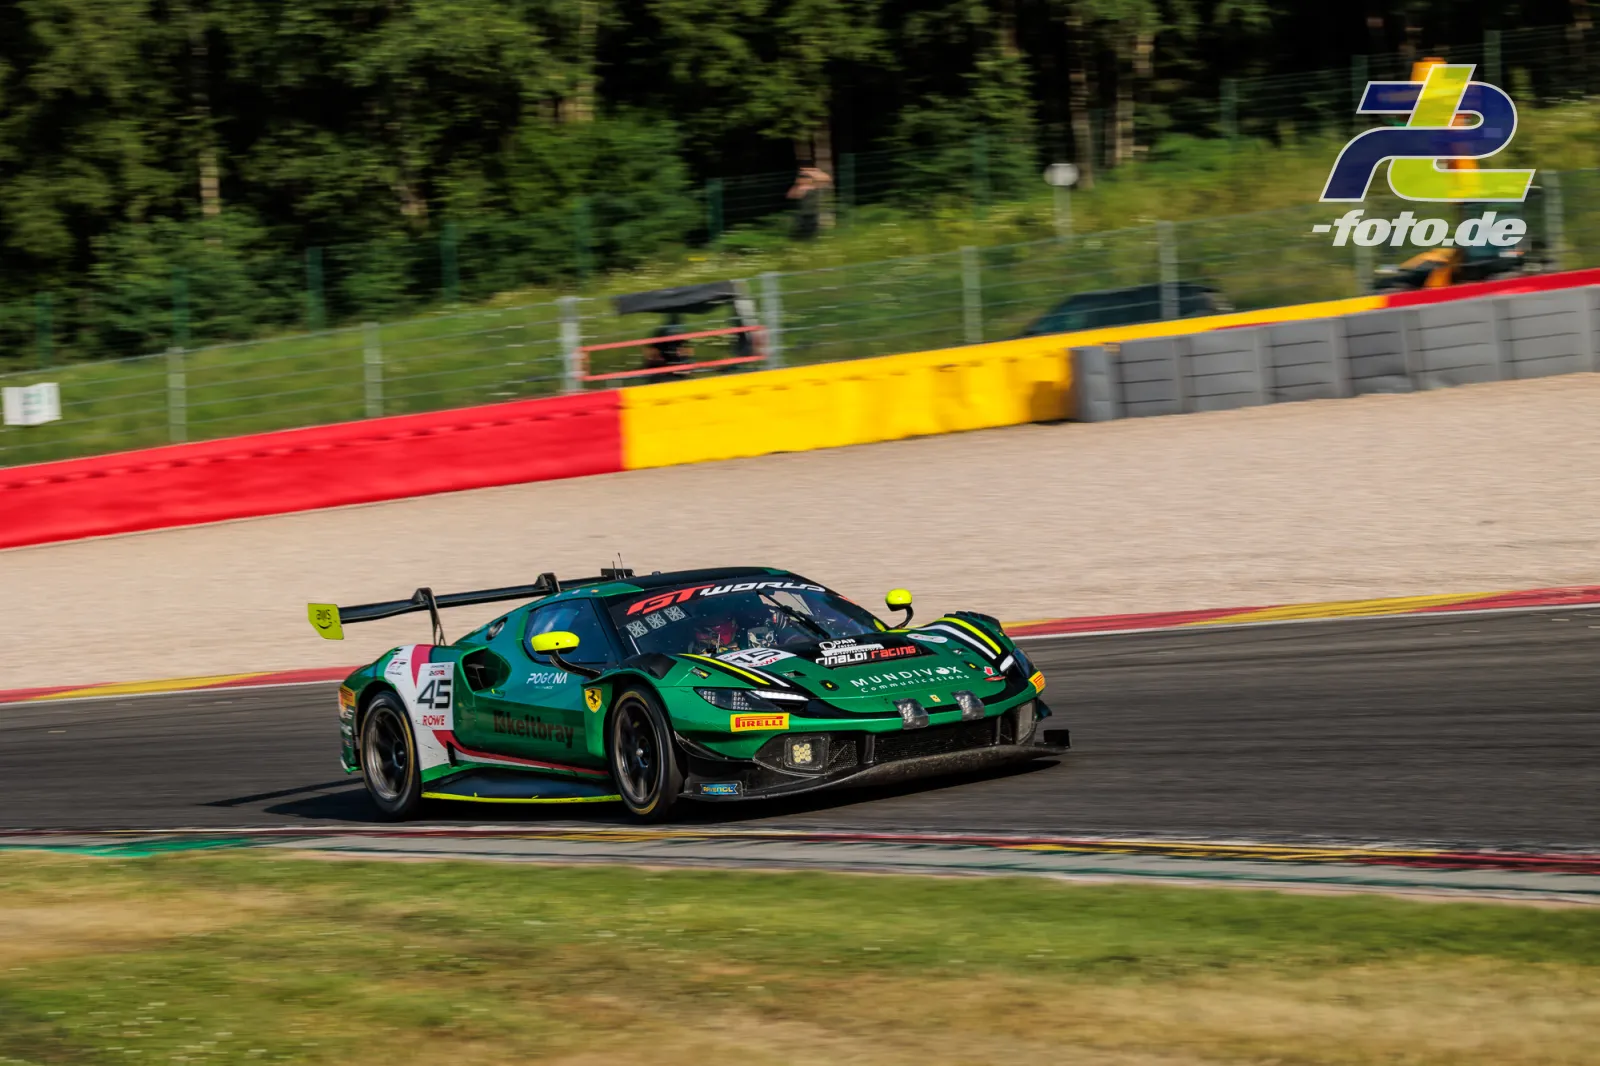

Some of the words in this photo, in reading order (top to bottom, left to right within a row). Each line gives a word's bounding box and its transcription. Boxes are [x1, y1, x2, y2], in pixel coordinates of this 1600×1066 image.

[626, 583, 715, 616] GT
[861, 674, 970, 693] Communications
[417, 679, 452, 710] 45
[422, 714, 446, 727] ROWE
[735, 715, 784, 729] PIRELLI
